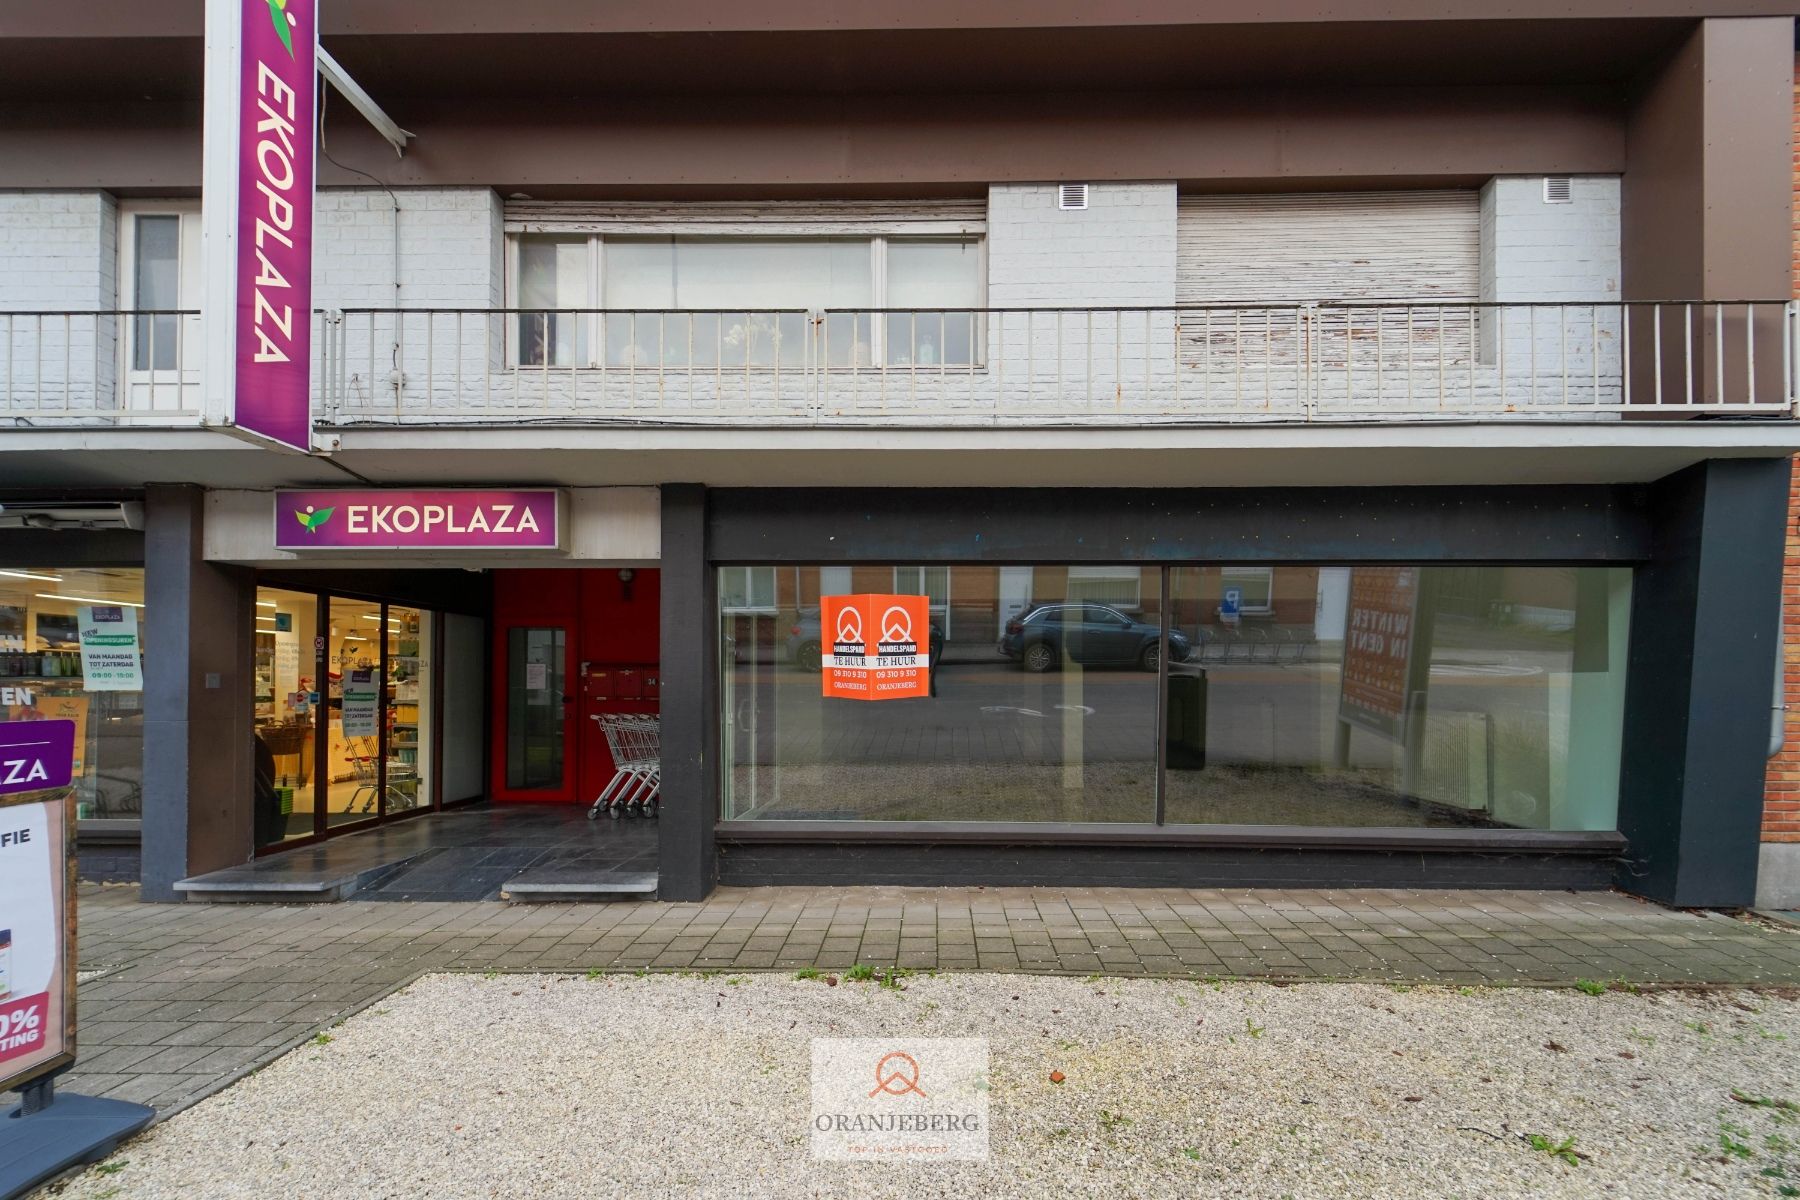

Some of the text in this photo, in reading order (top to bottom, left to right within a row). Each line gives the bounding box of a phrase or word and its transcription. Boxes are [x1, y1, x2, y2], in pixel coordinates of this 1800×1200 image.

[253, 60, 296, 364] EKOPLAZA
[347, 505, 540, 533] EKOPLAZA
[834, 646, 864, 654] HANDELSPAND
[878, 644, 916, 652] HANDELSPAND
[834, 656, 866, 666] TE HUUR
[876, 656, 916, 666] TE HUUR
[834, 682, 866, 690] ORANJEBERG
[876, 682, 916, 690] ORANJEBERG
[0, 758, 48, 785] ZA
